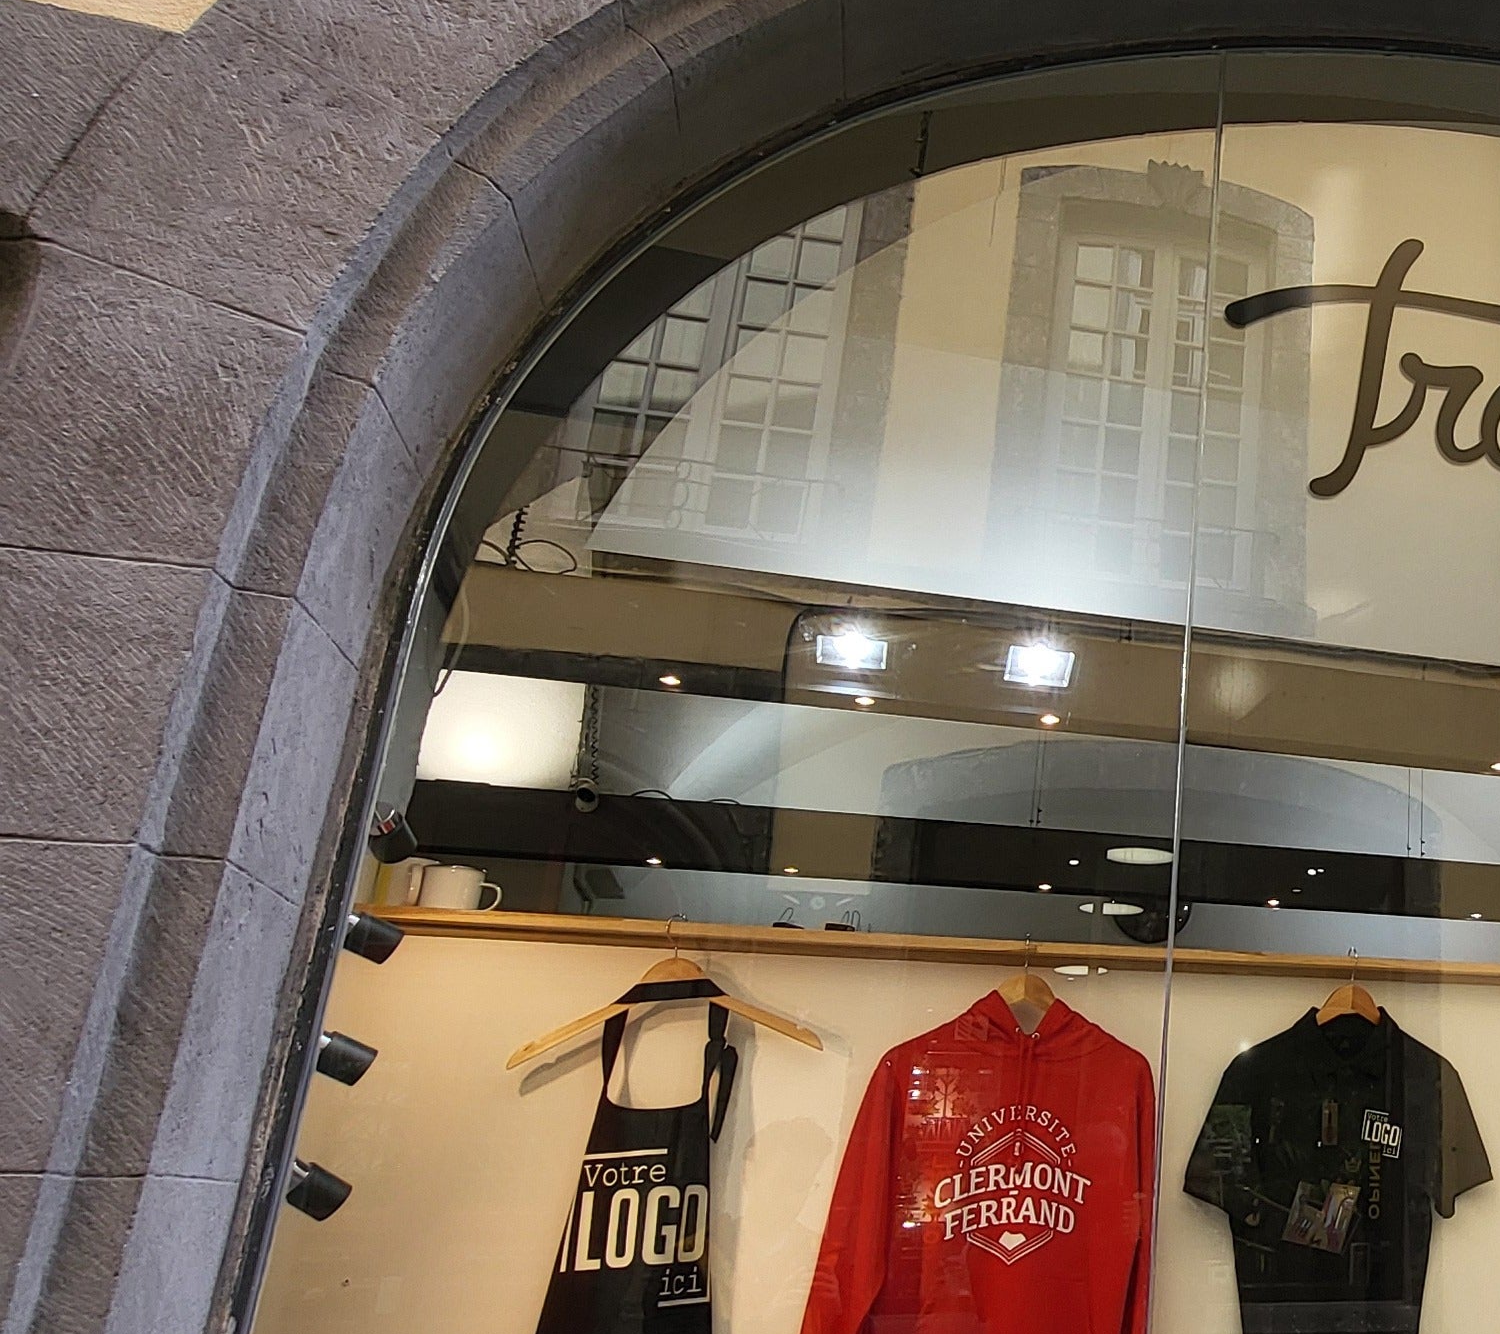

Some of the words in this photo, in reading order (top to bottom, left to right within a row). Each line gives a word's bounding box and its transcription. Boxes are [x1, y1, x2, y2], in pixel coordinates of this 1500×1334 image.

[956, 1104, 1076, 1158] UNIVERSITE
[1364, 1119, 1400, 1147] LOGO
[1367, 1112, 1389, 1123] Votre
[584, 1162, 666, 1187] Votre
[933, 1161, 1091, 1208] CLERMONT
[574, 1184, 708, 1271] LOGO
[943, 1196, 1075, 1241] FERRAND
[659, 1267, 701, 1296] ici
